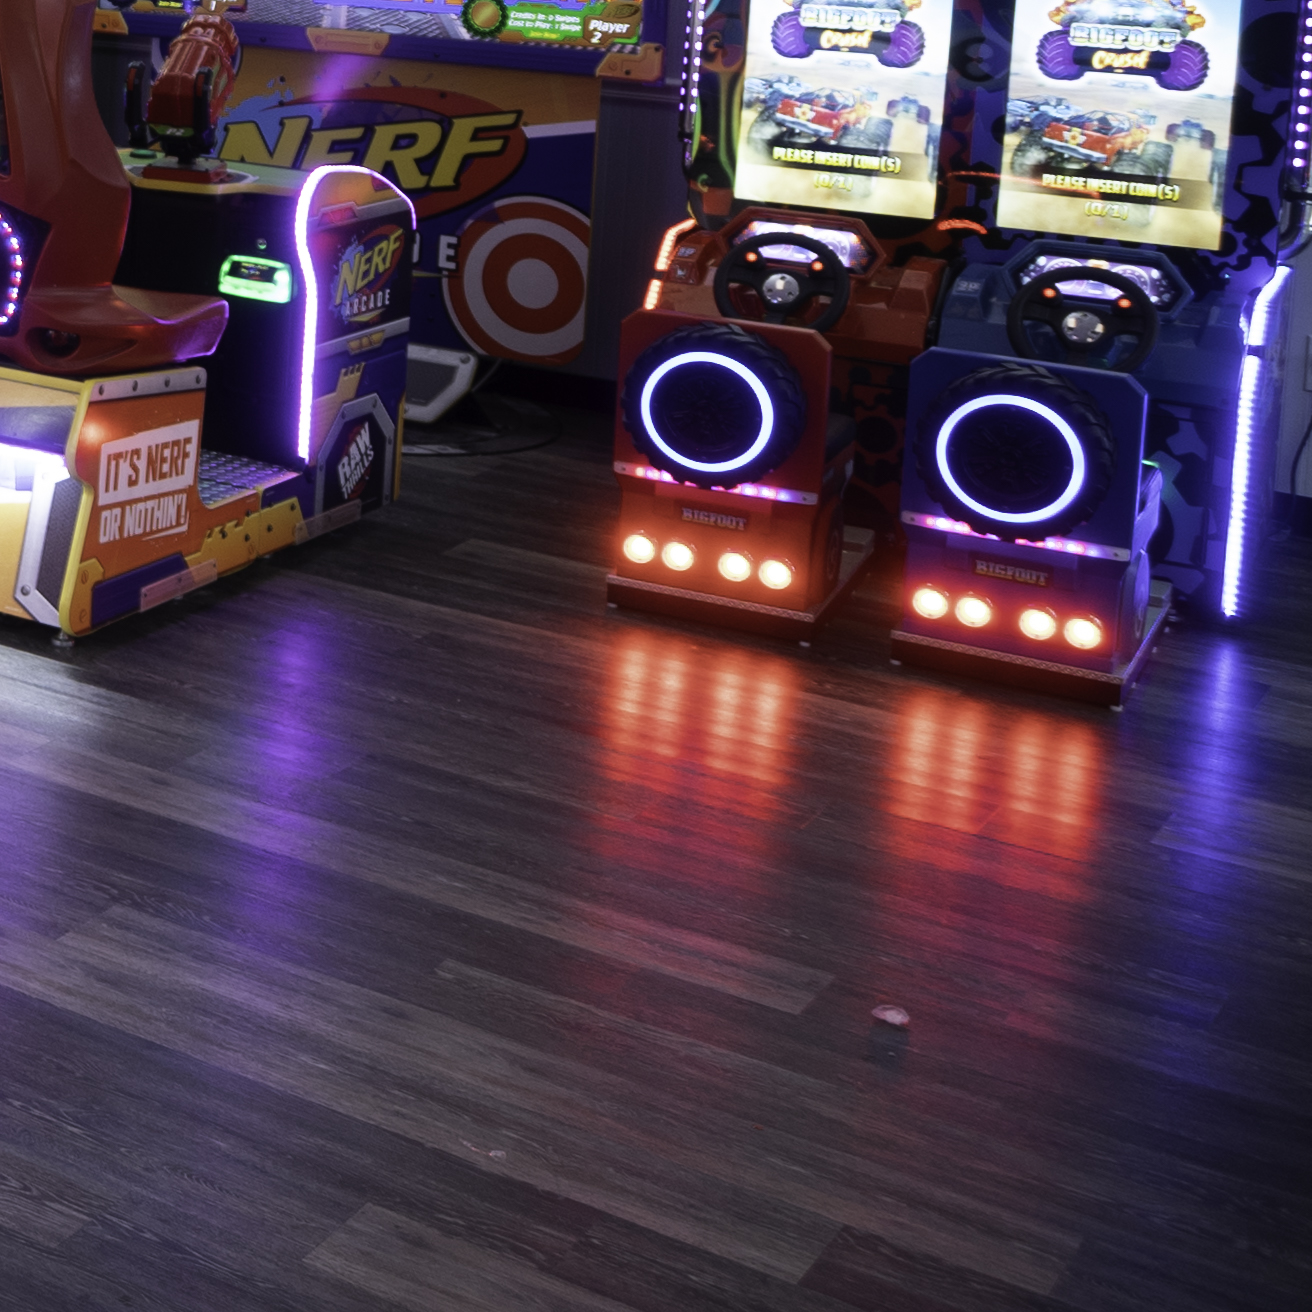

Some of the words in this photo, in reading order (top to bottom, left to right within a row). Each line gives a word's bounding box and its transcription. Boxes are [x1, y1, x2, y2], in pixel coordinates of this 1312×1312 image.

[588, 19, 631, 34] Player
[803, 6, 899, 30] BIGFOOT
[590, 31, 602, 43] 2
[1073, 25, 1180, 49] BIGFOOT
[1091, 49, 1152, 70] CRUSH
[215, 109, 525, 192] NERF
[772, 145, 815, 164] PLEASE
[814, 149, 854, 168] INSERT
[1041, 173, 1086, 191] PLEASE
[1085, 176, 1130, 196] INSERT
[334, 227, 405, 307] NERF
[344, 288, 392, 318] ARCADE
[104, 447, 142, 494] IT'S
[145, 436, 193, 485] NERF
[337, 421, 372, 488] RAW
[99, 507, 122, 545] OR
[123, 492, 188, 539] NOTHIN'!
[681, 506, 747, 531] BIGFOOT
[975, 559, 1049, 587] BIGFOOT
